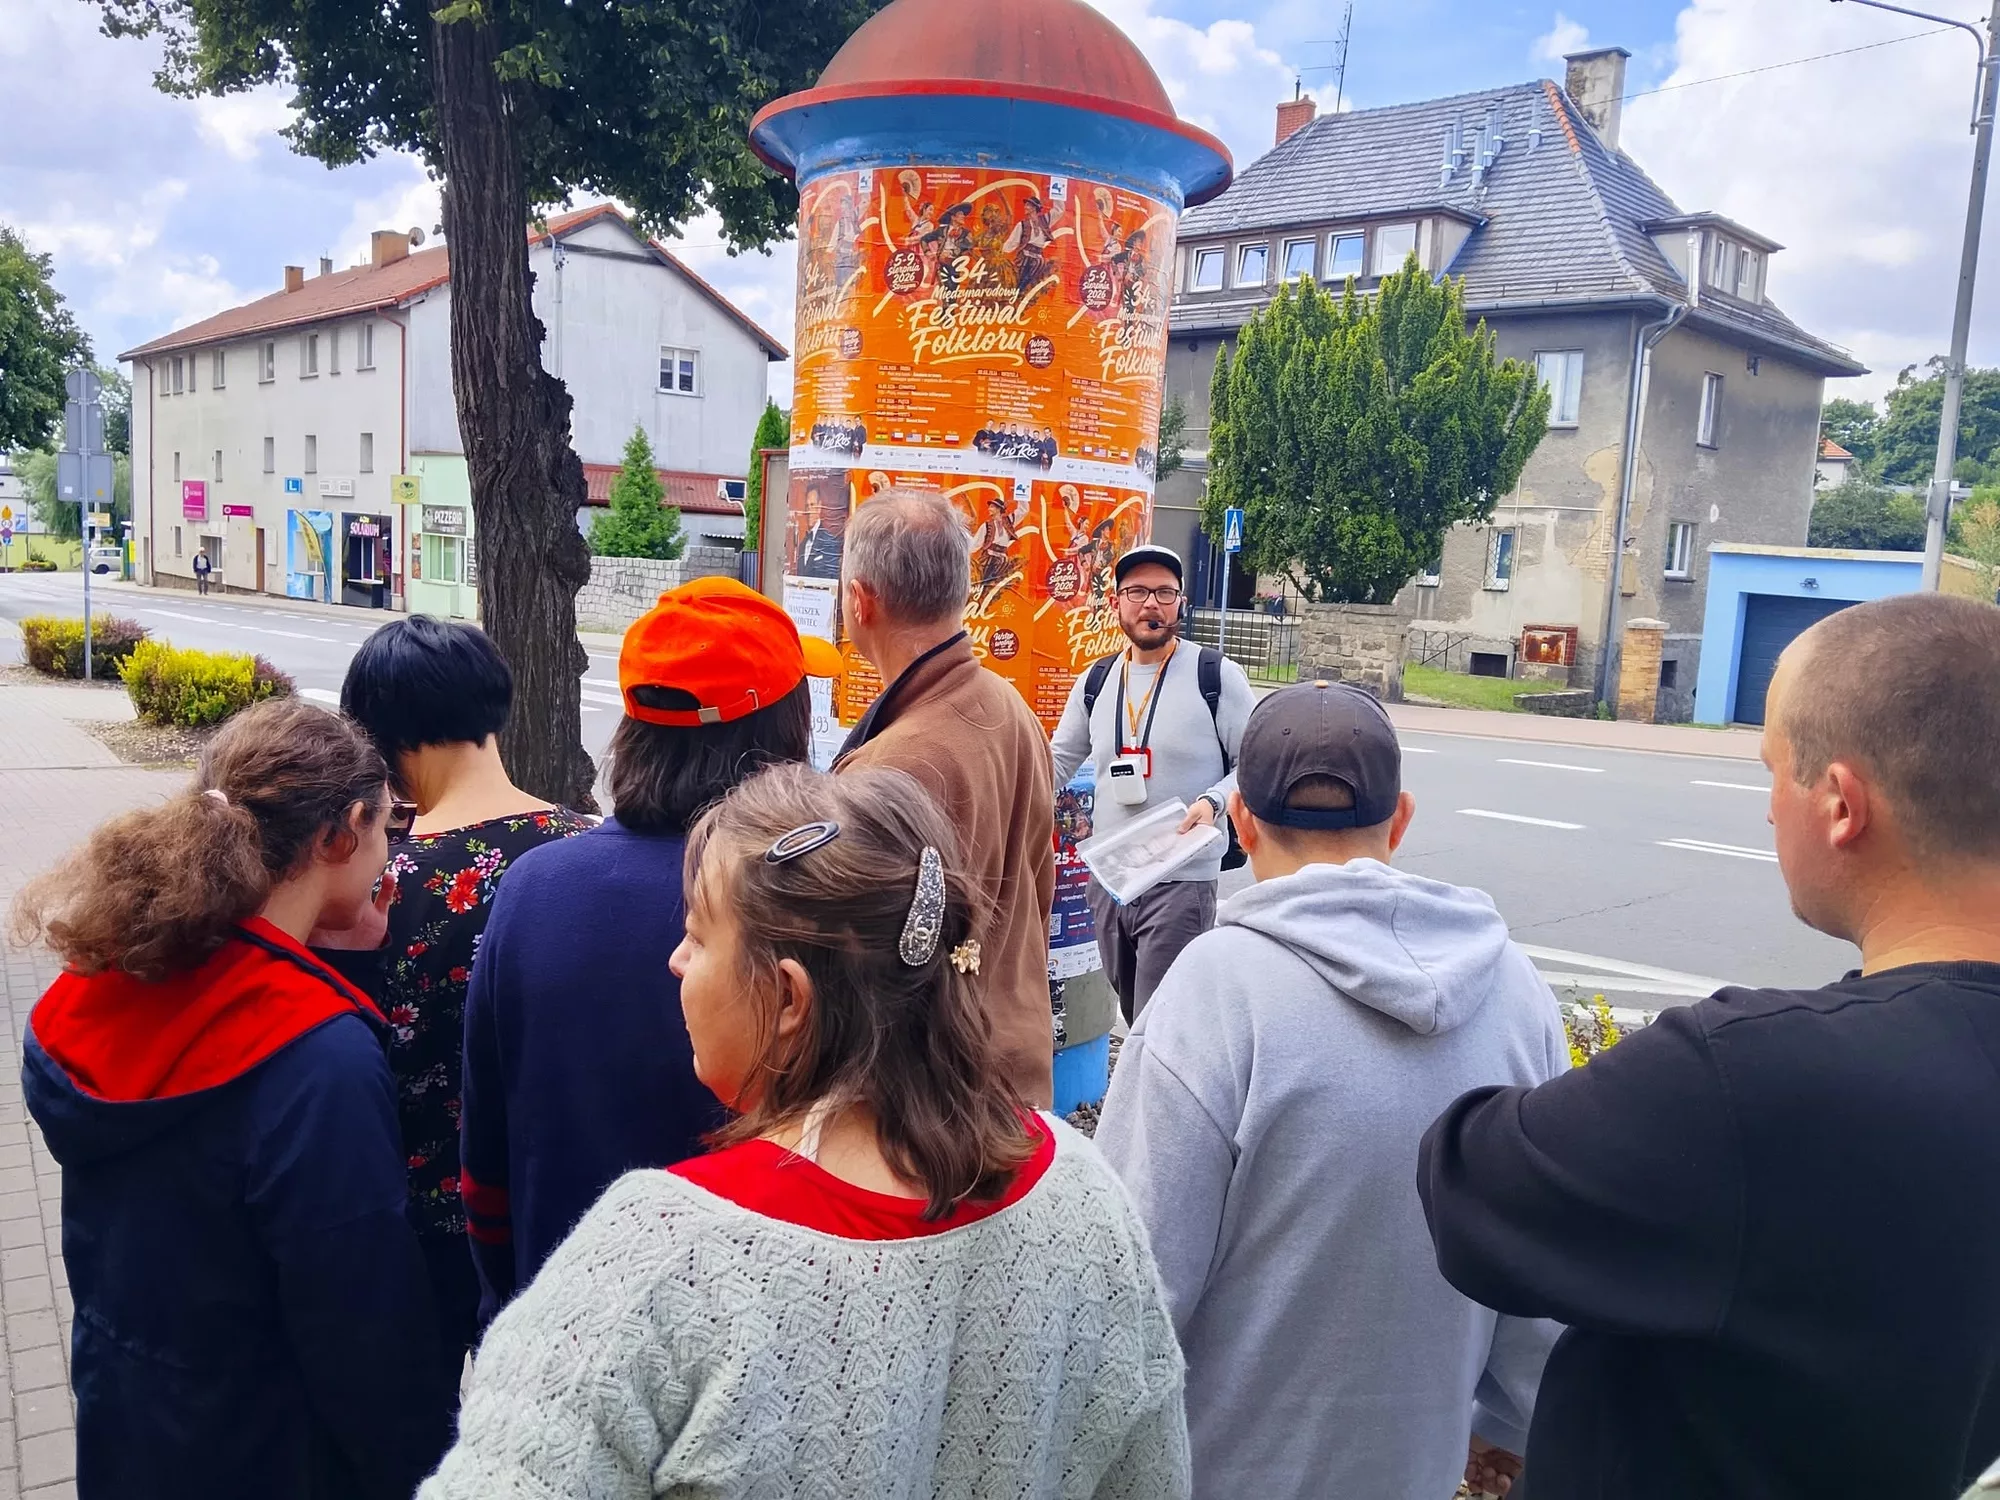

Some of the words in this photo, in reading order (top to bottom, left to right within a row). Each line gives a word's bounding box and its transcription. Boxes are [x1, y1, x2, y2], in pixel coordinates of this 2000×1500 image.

[893, 252, 915, 266] 5-9
[951, 256, 988, 284] 34
[892, 272, 915, 283] 2026
[931, 284, 1020, 303] Międzynarodowy
[1087, 289, 1106, 299] 2026
[1131, 280, 1151, 309] 34
[906, 274, 1060, 331] Festiwal
[909, 325, 1026, 365] Folkloru
[289, 480, 297, 490] L
[434, 510, 463, 525] PIZZERIA
[350, 522, 380, 536] SOLARIUM
[1055, 563, 1074, 576] 5-9
[1054, 582, 1074, 592] 2026
[1067, 630, 1131, 667] Folklor
[1054, 851, 1083, 864] 25-2
